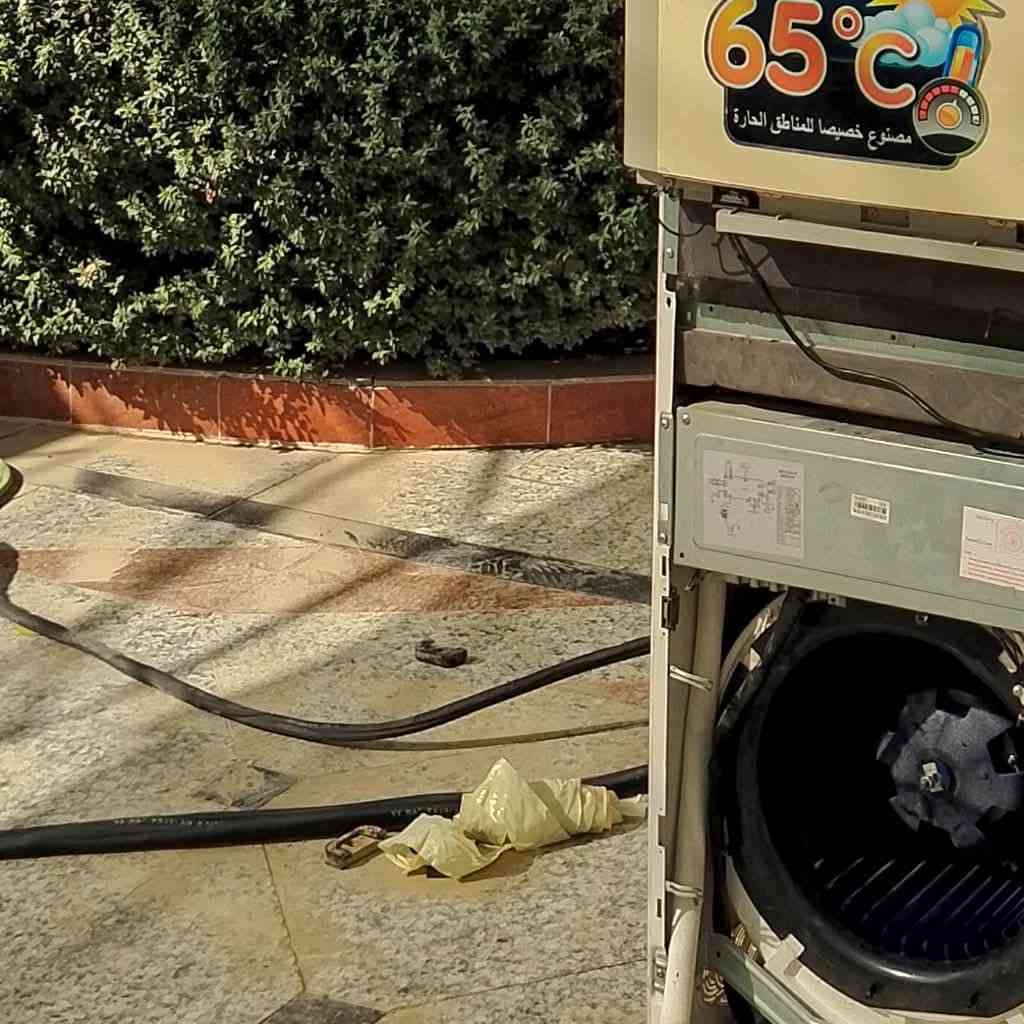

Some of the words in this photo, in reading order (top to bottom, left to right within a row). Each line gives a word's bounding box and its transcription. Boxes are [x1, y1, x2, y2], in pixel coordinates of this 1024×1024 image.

[733, 108, 767, 128] الحارة
[770, 113, 814, 134] للمناطق
[818, 118, 863, 140] خصيصا
[867, 127, 912, 150] مصنوع
